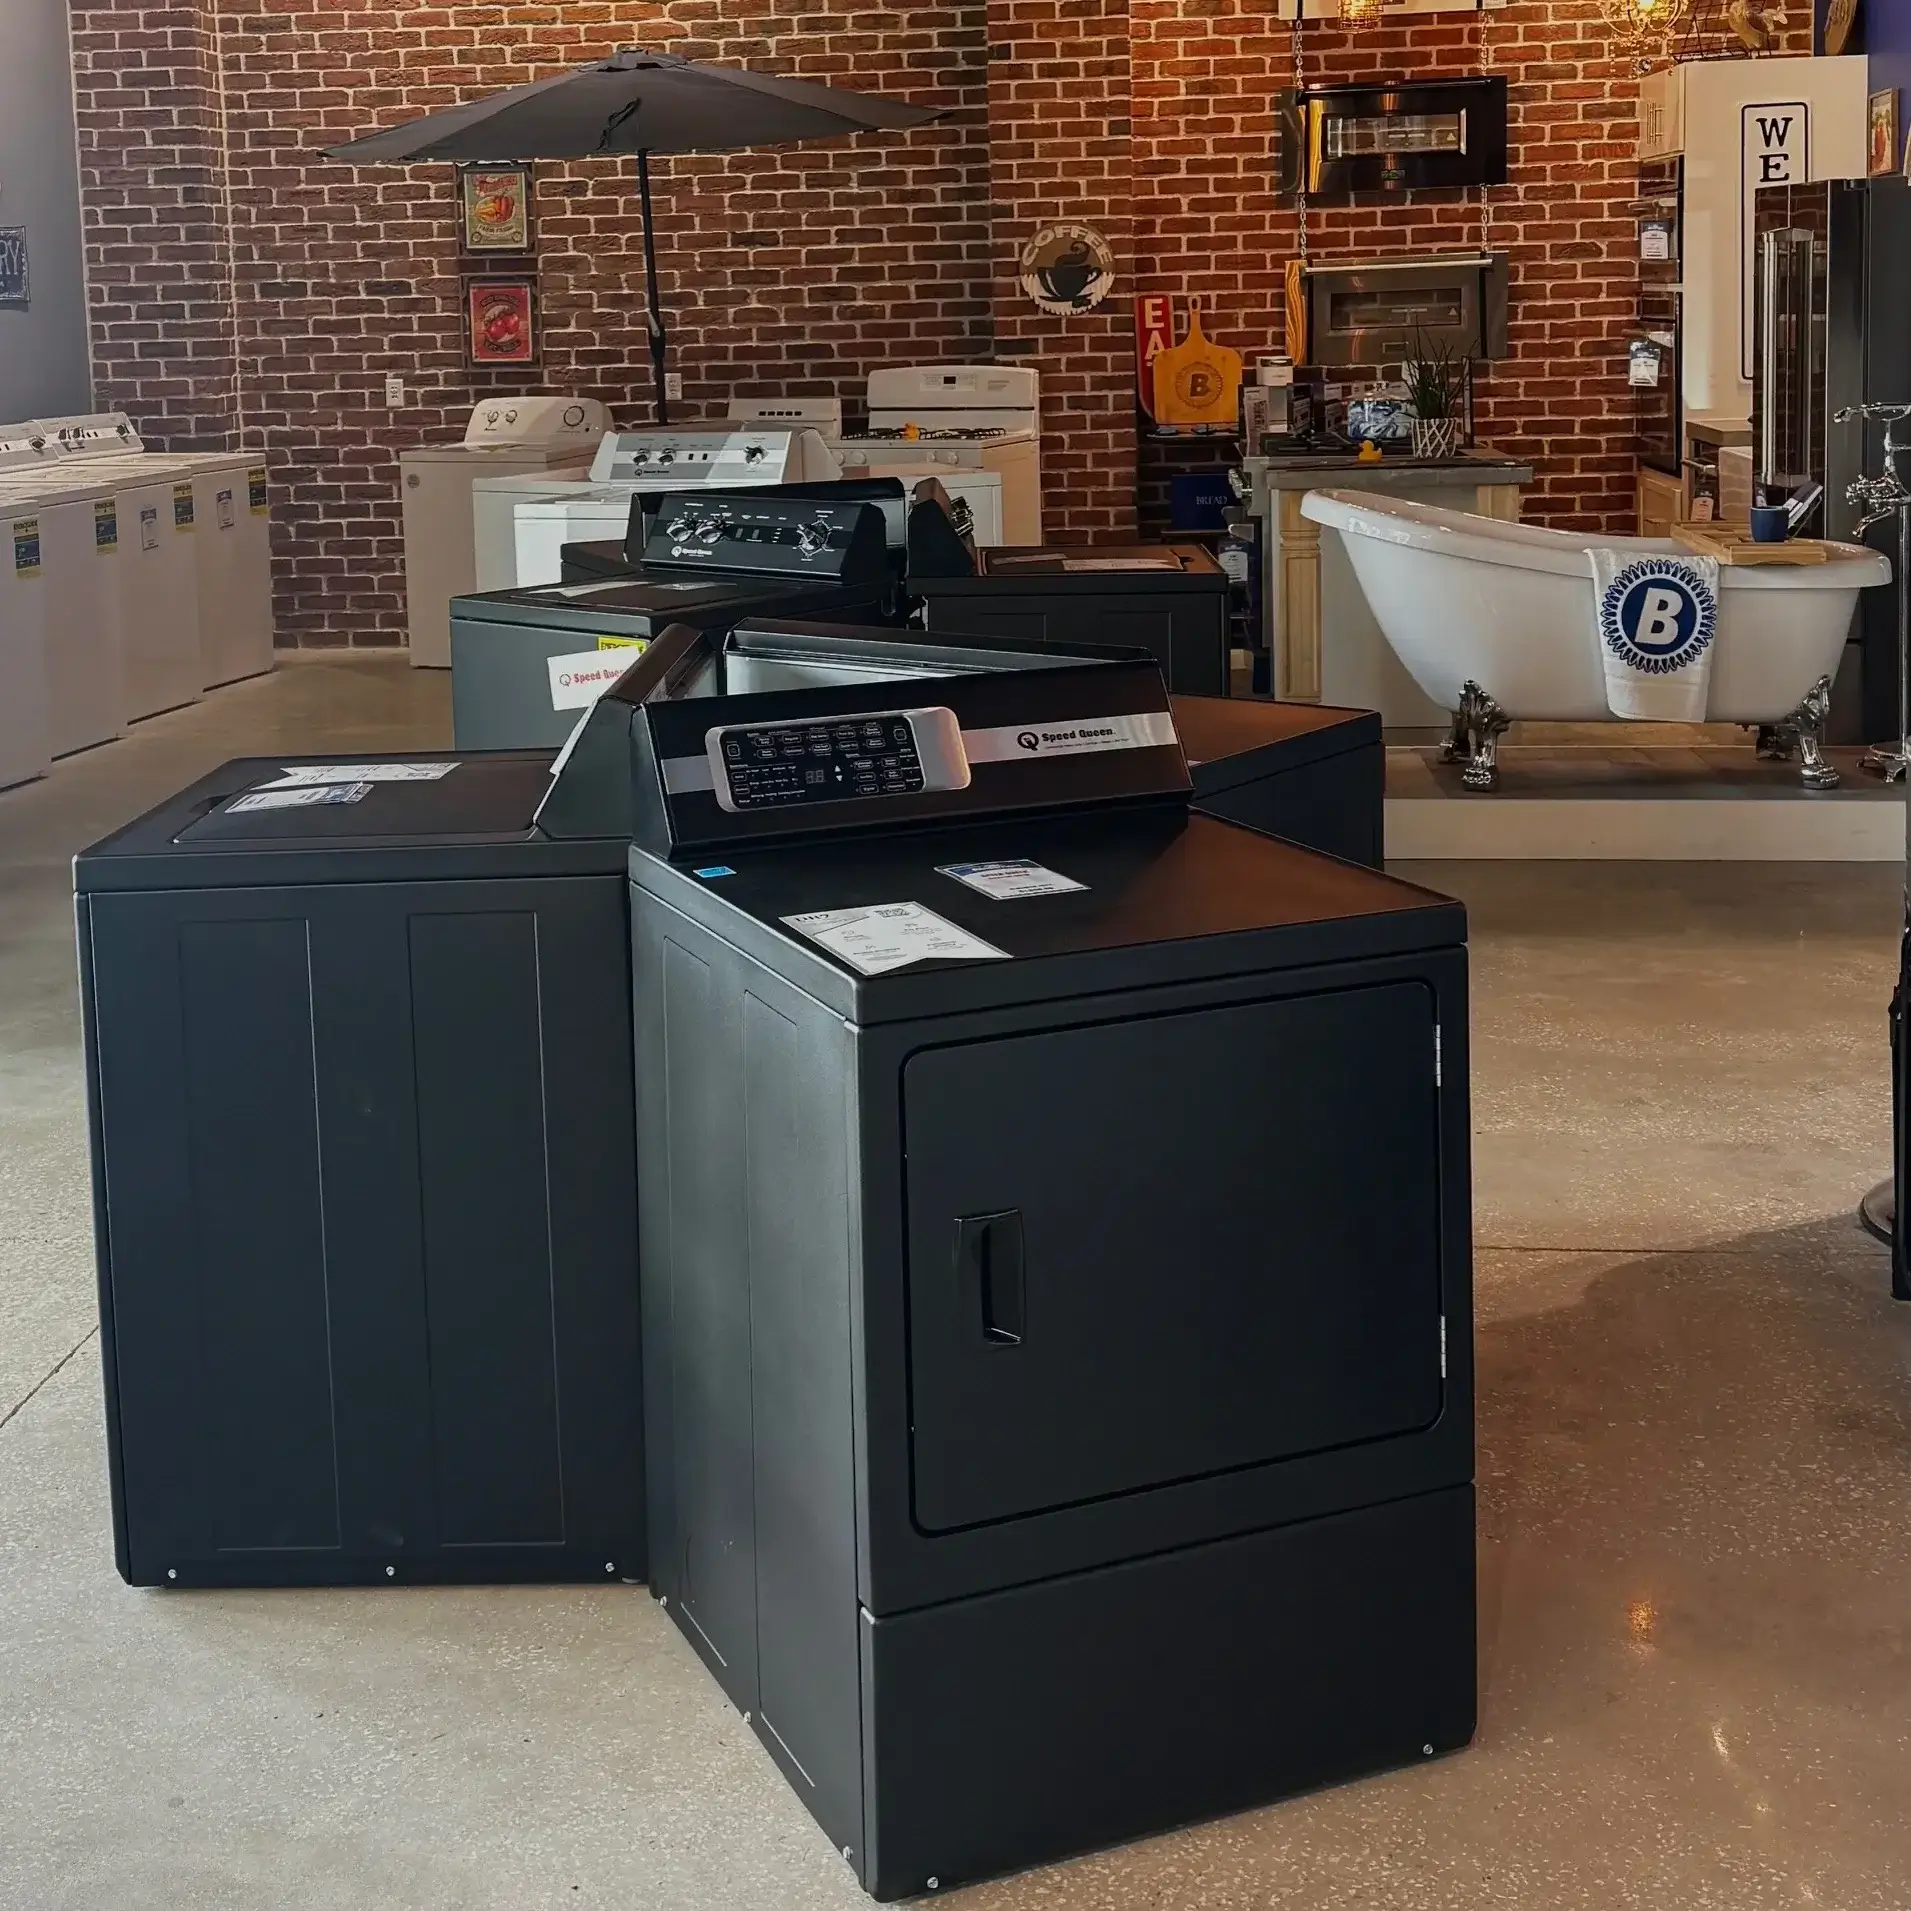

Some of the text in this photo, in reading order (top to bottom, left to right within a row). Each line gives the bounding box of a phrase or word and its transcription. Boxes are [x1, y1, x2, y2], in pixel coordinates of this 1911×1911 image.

[1755, 117, 1793, 182] WE
[1022, 225, 1113, 266] COFFEE
[1143, 298, 1165, 367] EA
[1189, 373, 1212, 397] B
[1196, 495, 1228, 505] BREAD
[1634, 587, 1684, 645] B
[573, 671, 601, 684] Speed
[1041, 730, 1076, 743] Speed
[1079, 728, 1114, 738] Queen
